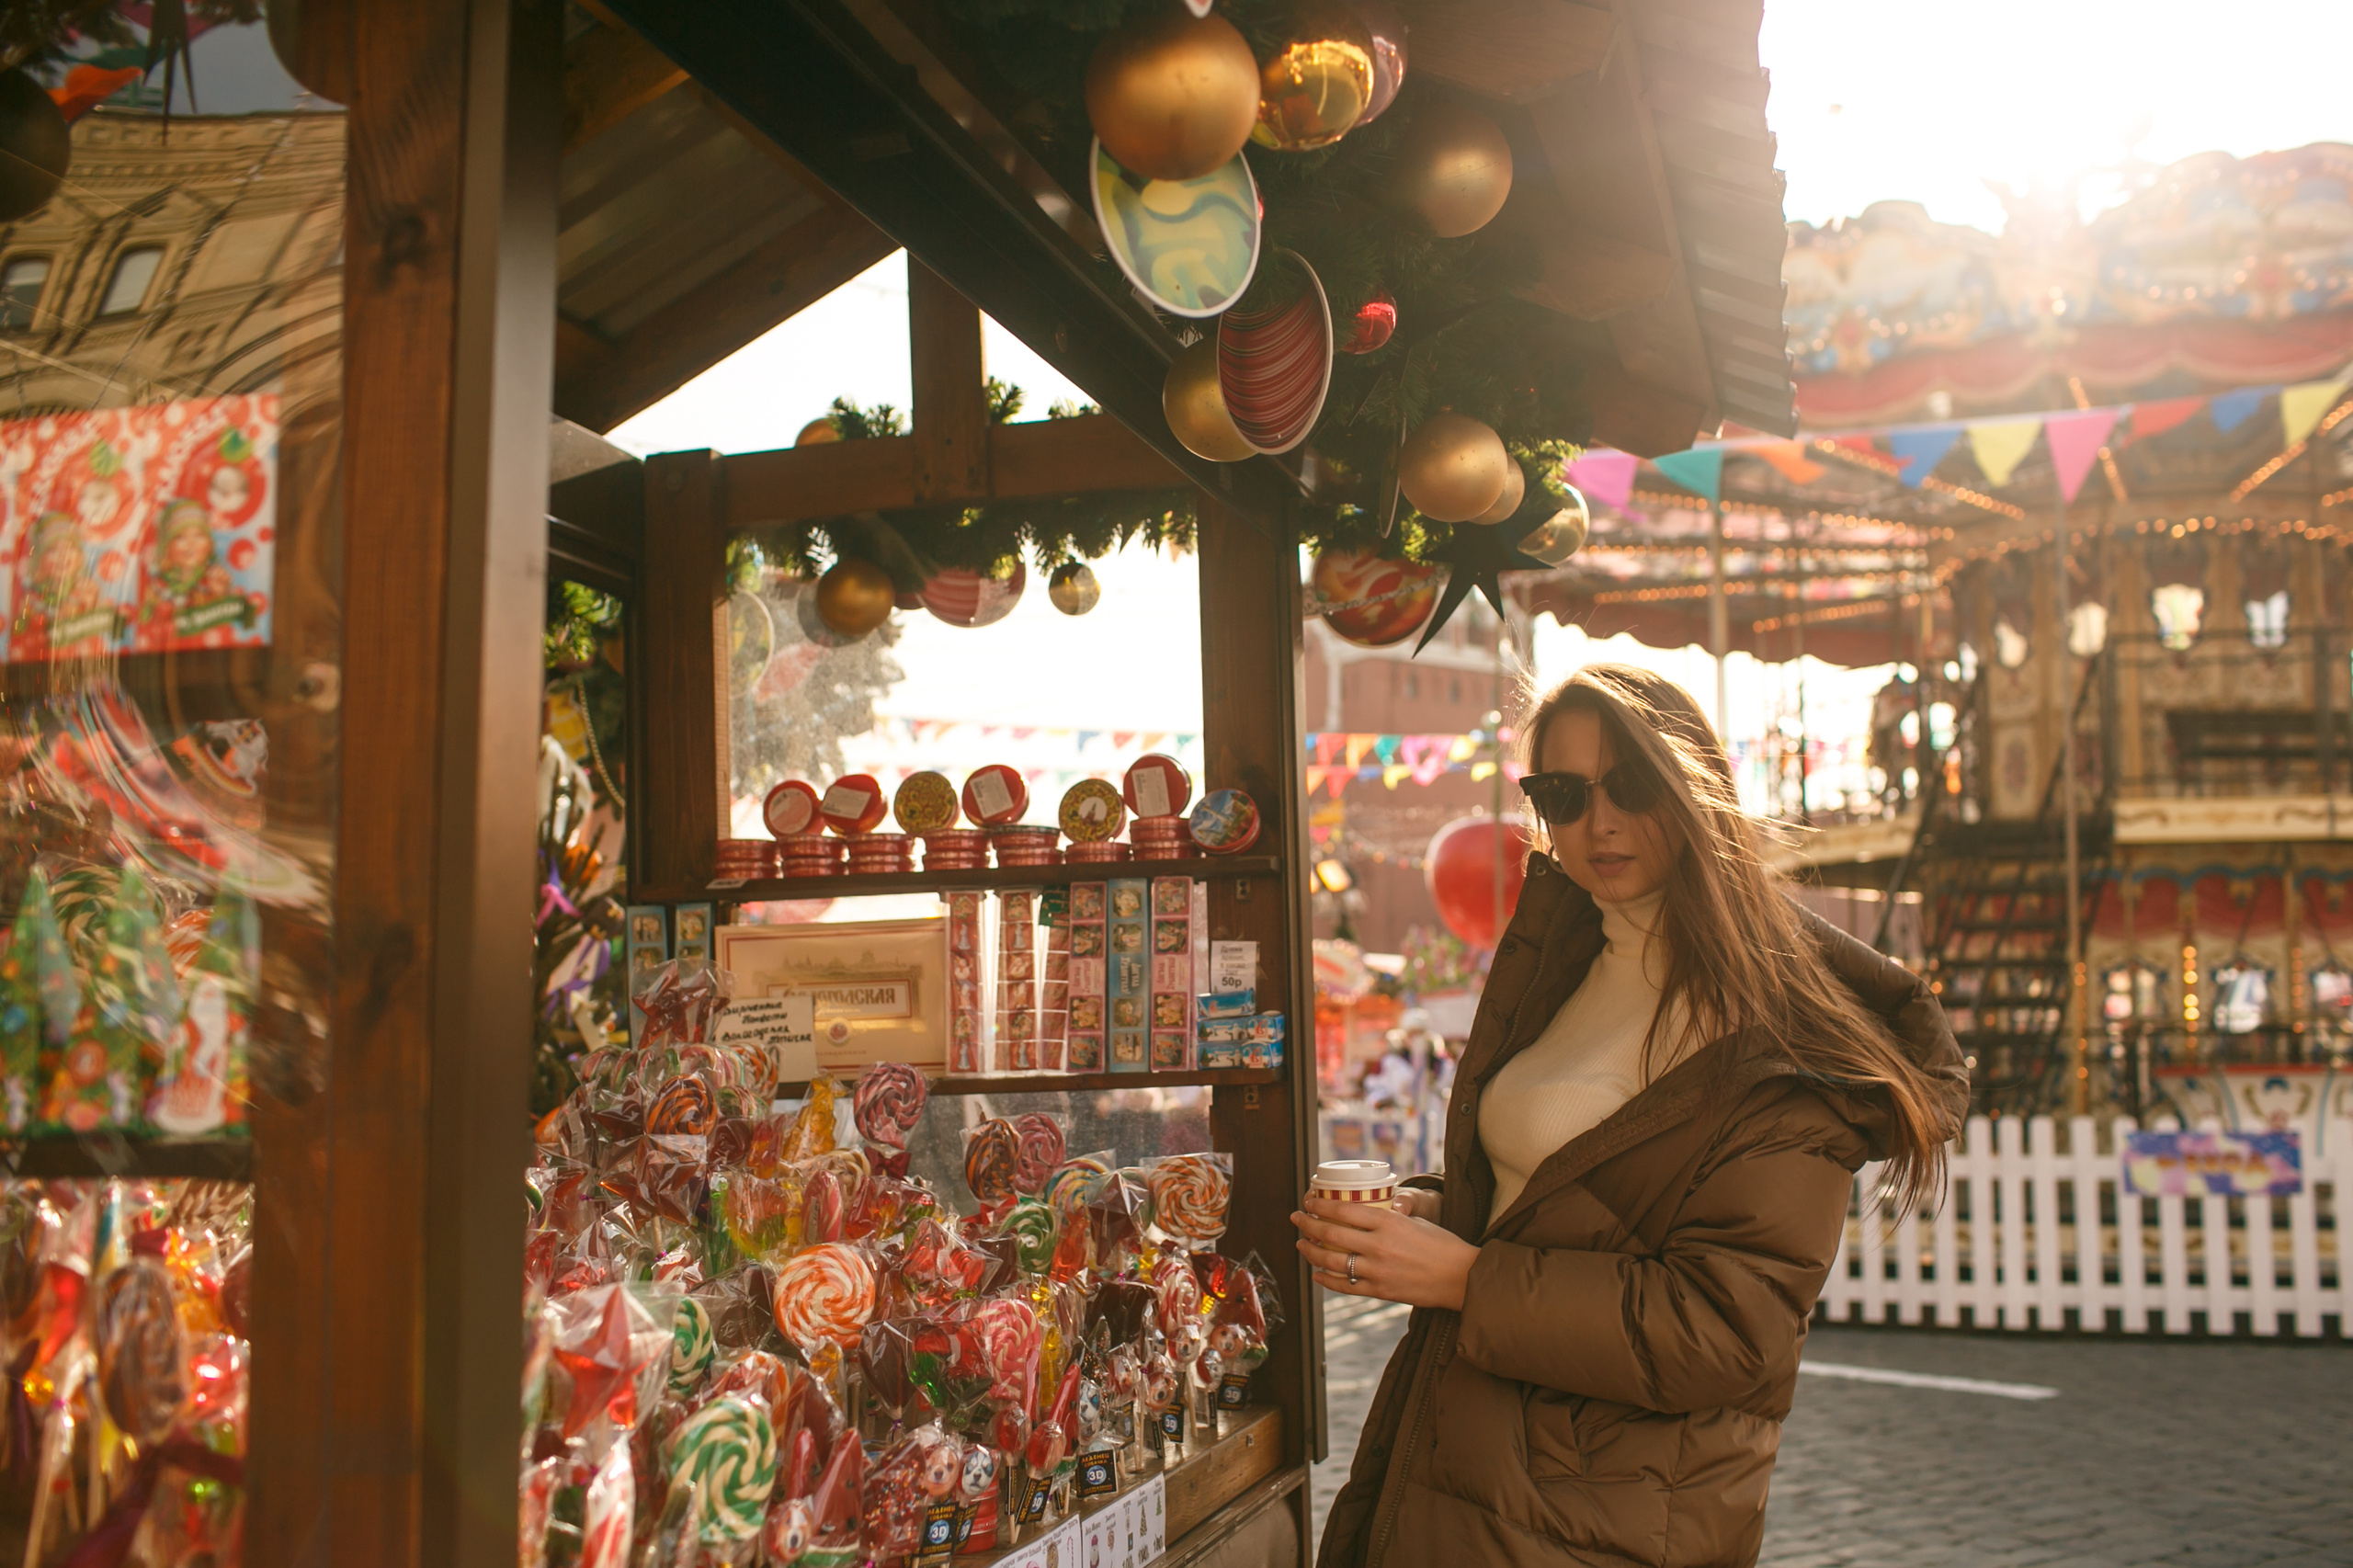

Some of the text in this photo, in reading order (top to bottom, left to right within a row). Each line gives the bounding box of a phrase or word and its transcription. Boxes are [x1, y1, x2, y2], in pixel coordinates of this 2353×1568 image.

[1222, 976, 1243, 989] 50р
[783, 987, 896, 1006] ОГОДСКАЯ
[1225, 1389, 1238, 1399] 3D
[1165, 1417, 1176, 1428] 3D
[1082, 1453, 1109, 1463] ЛЕДЕНЕЦ
[1085, 1460, 1107, 1468] СОБАЧКА
[1089, 1470, 1104, 1481] 3D
[927, 1506, 956, 1516] ЛЕДЕНЕЦ
[931, 1525, 947, 1540] 3D
